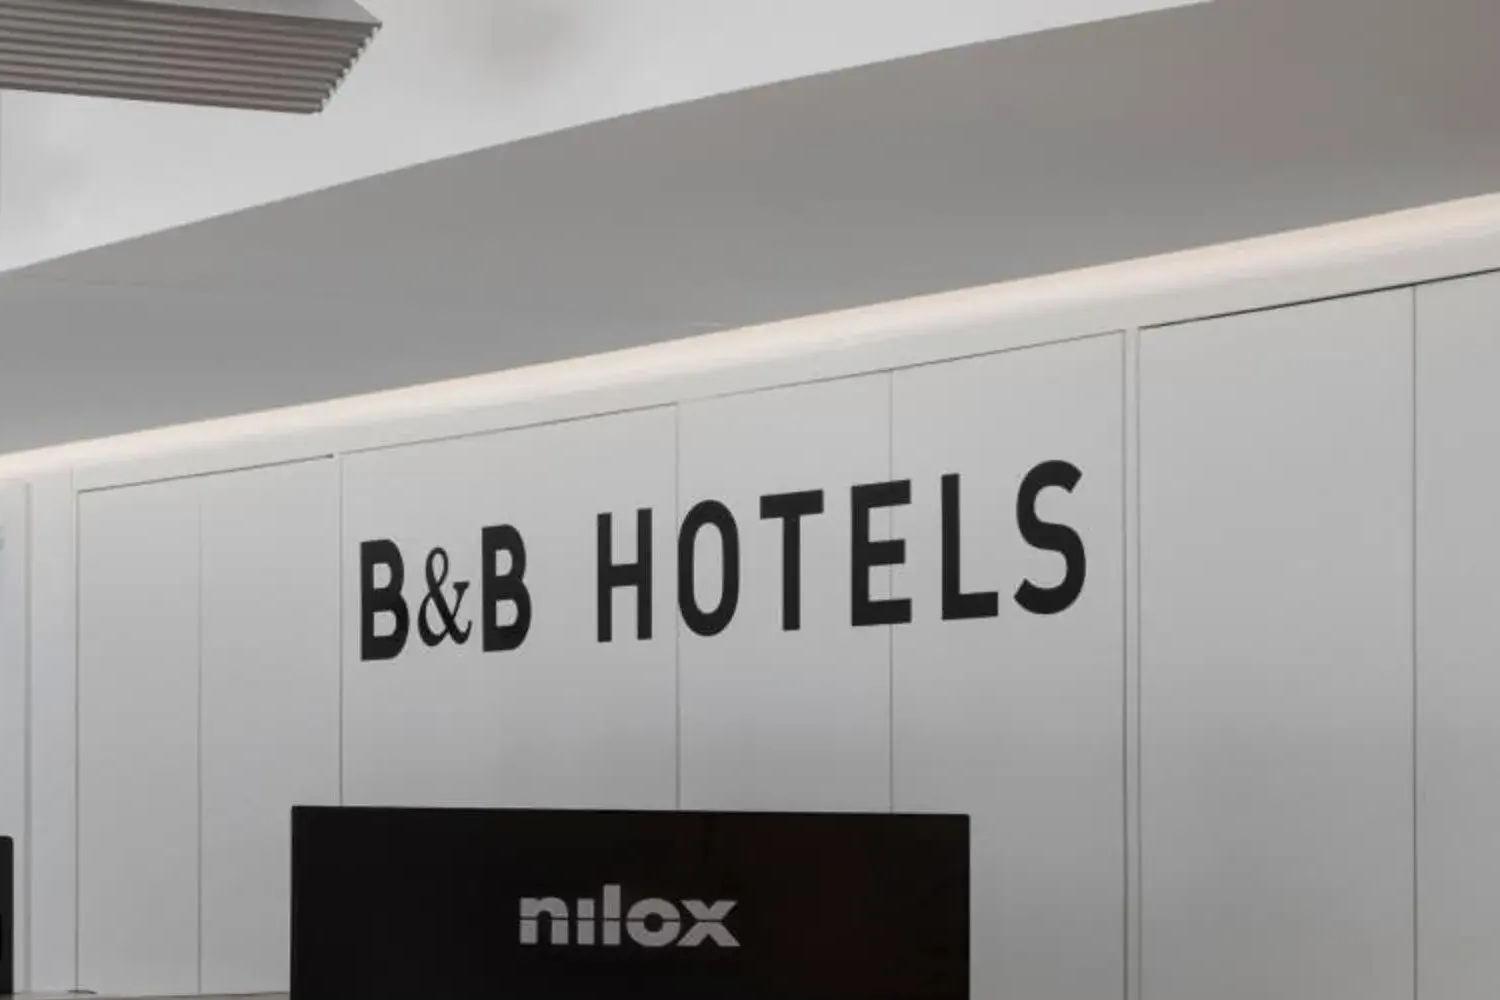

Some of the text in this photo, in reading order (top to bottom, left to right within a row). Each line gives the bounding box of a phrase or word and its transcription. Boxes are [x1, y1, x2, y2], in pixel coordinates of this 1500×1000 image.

[360, 459, 1086, 661] B&B HOTELS
[519, 884, 741, 947] nilox
